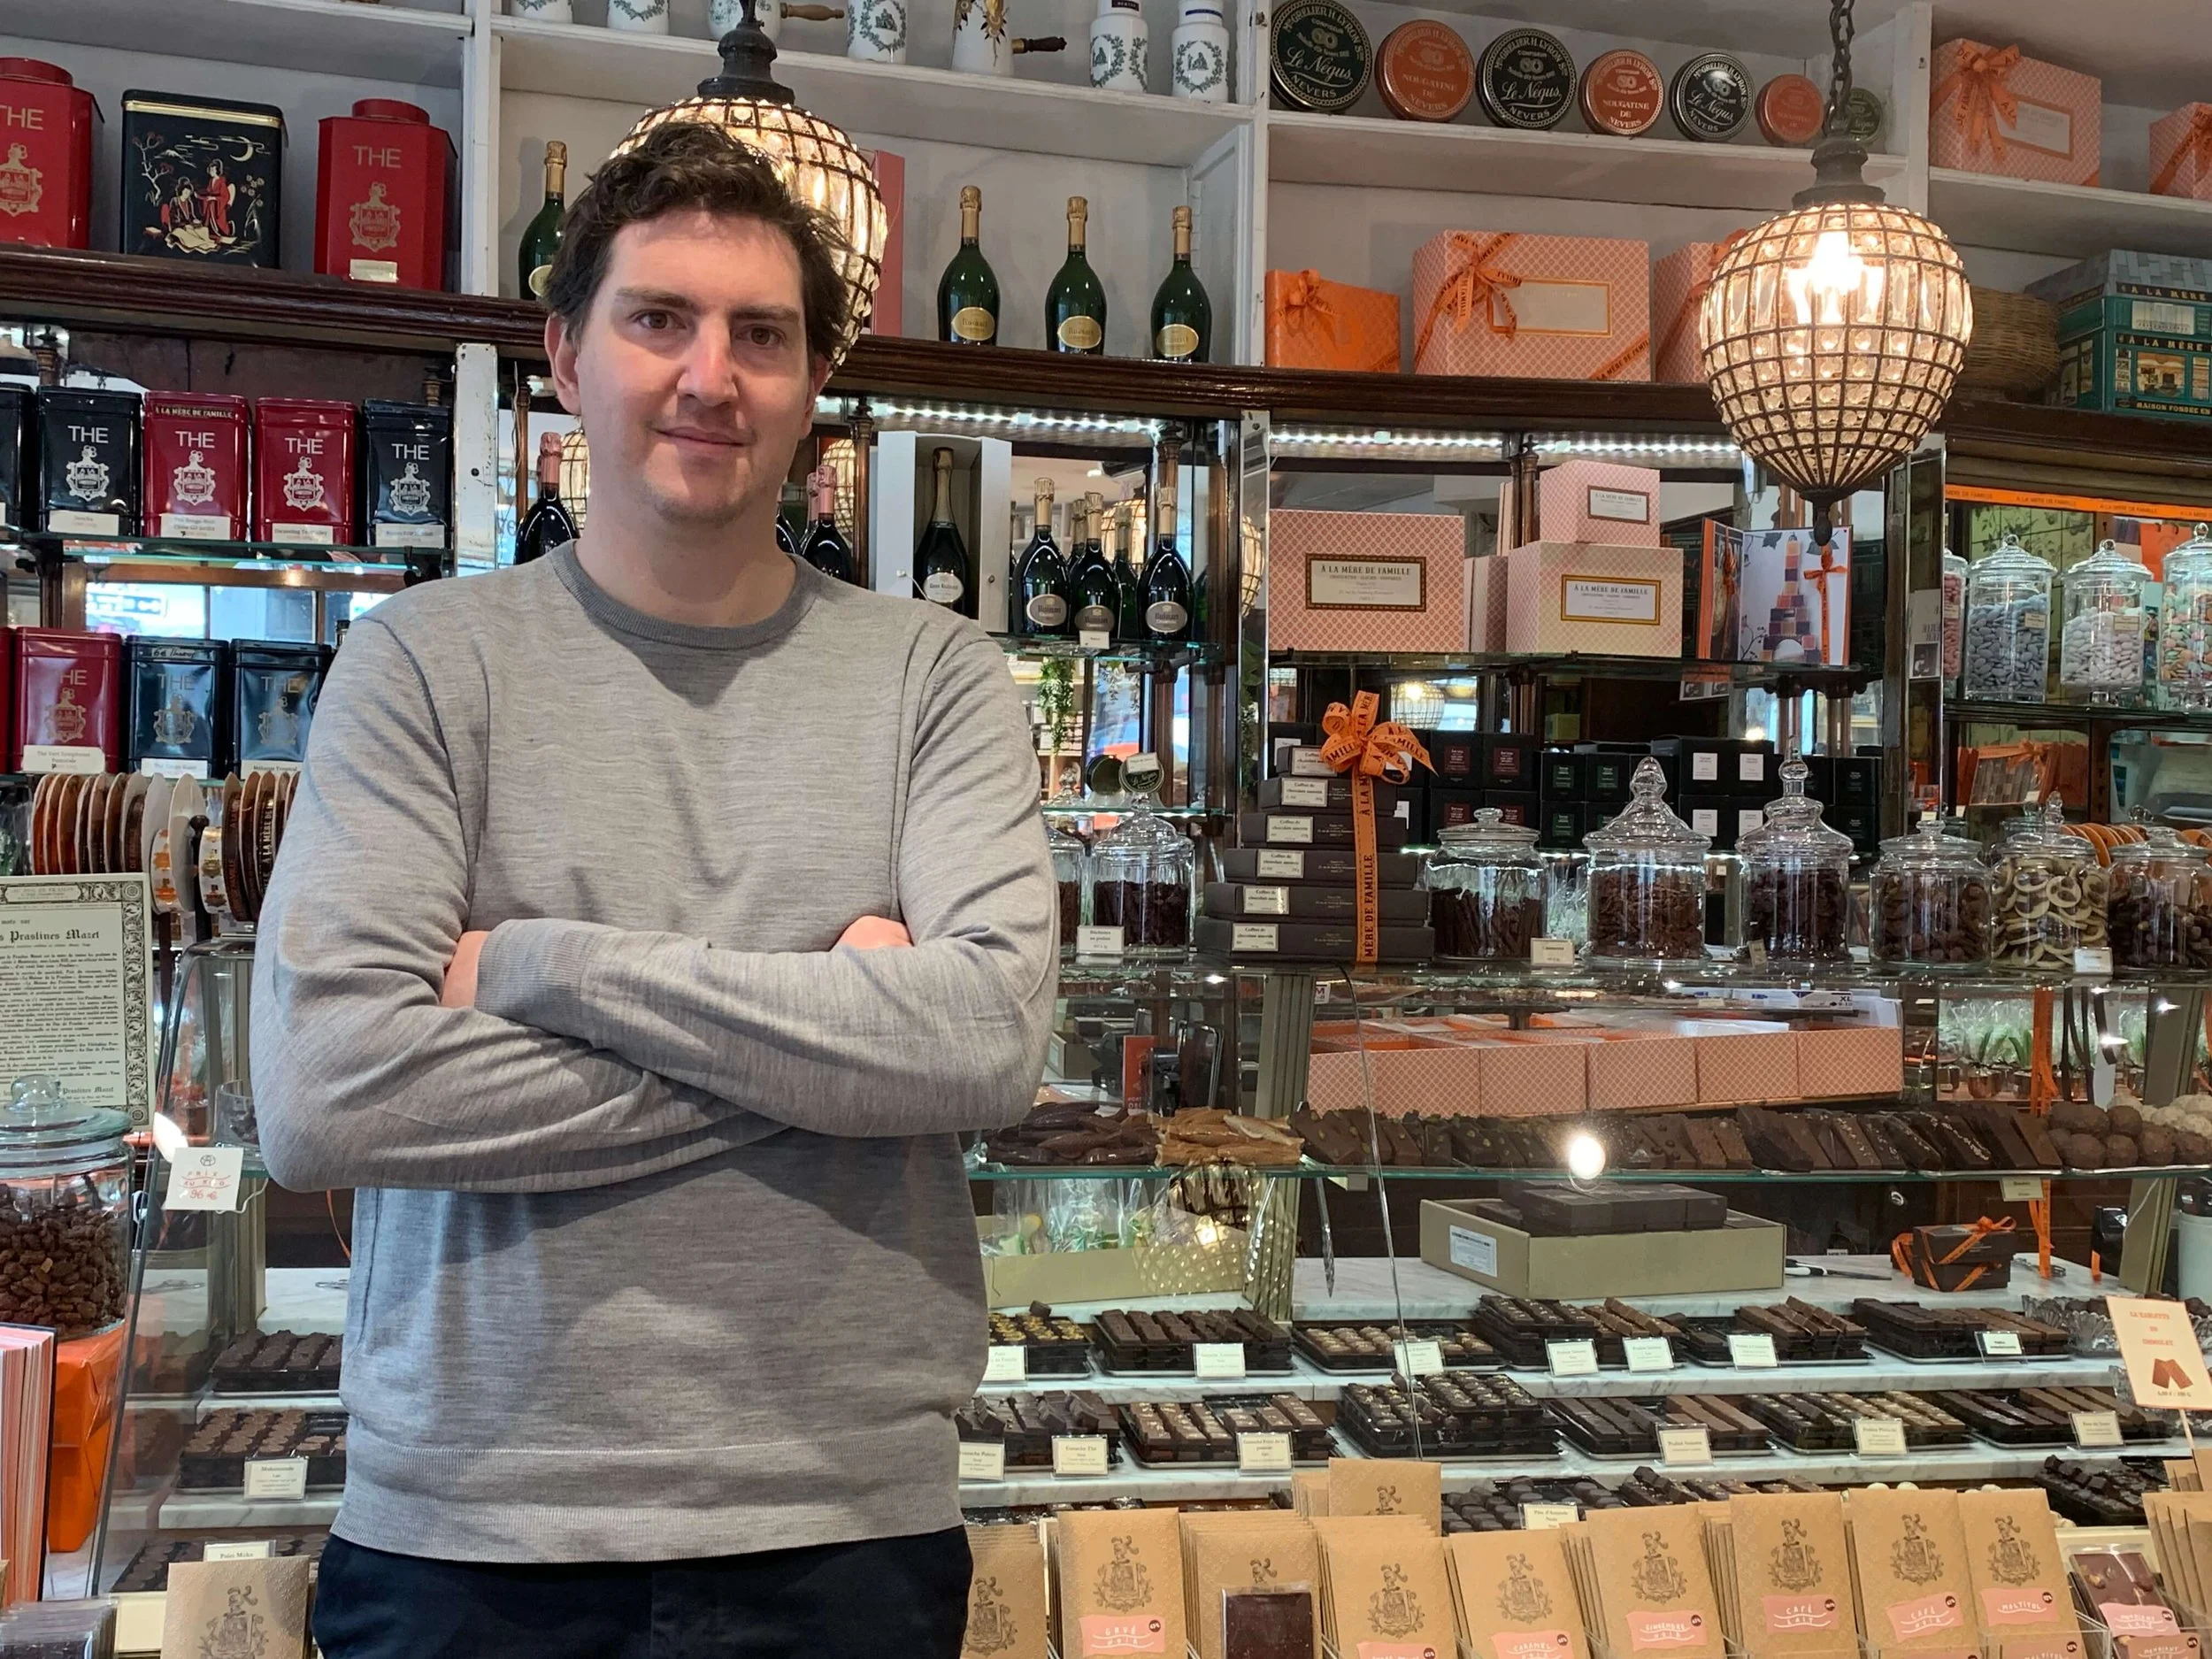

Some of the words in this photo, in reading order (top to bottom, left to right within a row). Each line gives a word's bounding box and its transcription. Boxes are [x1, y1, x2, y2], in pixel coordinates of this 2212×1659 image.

[1285, 47, 1302, 68] Le
[1291, 73, 1337, 98] NEVERS
[1501, 82, 1517, 101] Le
[1602, 99, 1650, 111] NOUGATINE
[1688, 90, 1705, 106] Le
[1509, 106, 1550, 121] NEVERS
[1688, 110, 1719, 132] NEVERS
[1609, 116, 1642, 129] NEVERS
[352, 145, 402, 168] THE
[2146, 286, 2162, 296] LA
[2144, 337, 2159, 347] LA
[2137, 402, 2167, 411] MAISON
[67, 426, 109, 443] THE
[175, 431, 215, 449] THE
[284, 437, 324, 455] THE
[391, 443, 430, 460] THE
[1341, 565, 1363, 574] MÈRE
[1378, 567, 1411, 576] FAMILLE
[1620, 587, 1648, 595] FAMILLE
[157, 673, 196, 690] THE
[260, 676, 299, 694] THE
[1364, 855, 1374, 905] FAMILLE
[1365, 907, 1374, 923] DE
[10, 931, 60, 943] Praslines
[65, 929, 99, 940] Mazet
[1786, 1603, 1813, 1615] CAFÉ
[2001, 1601, 2041, 1610] MALTITOL
[1513, 1642, 1551, 1652] CARAMEL
